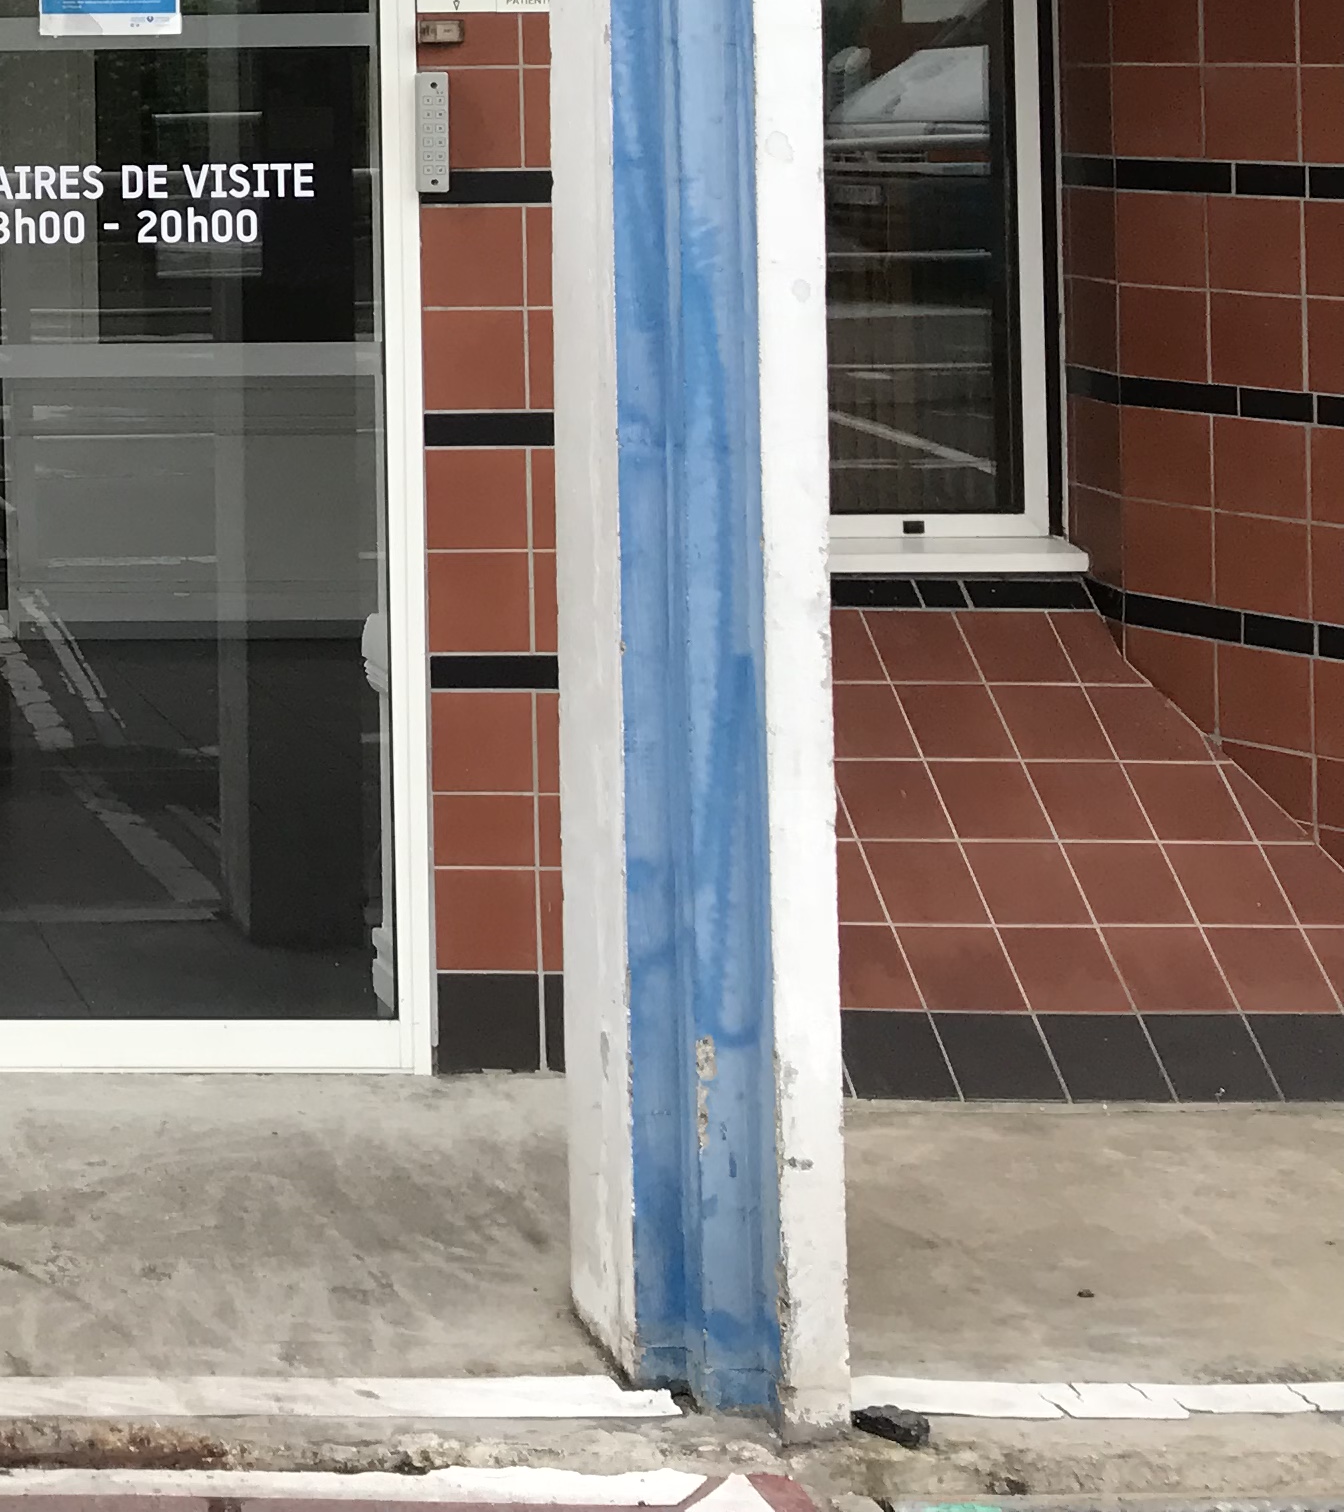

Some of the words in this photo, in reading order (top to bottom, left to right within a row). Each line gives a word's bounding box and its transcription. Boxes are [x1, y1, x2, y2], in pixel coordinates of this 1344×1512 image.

[121, 164, 168, 199] DE
[182, 162, 315, 198] VISITE
[103, 222, 119, 230] -
[137, 206, 258, 244] 20h00
